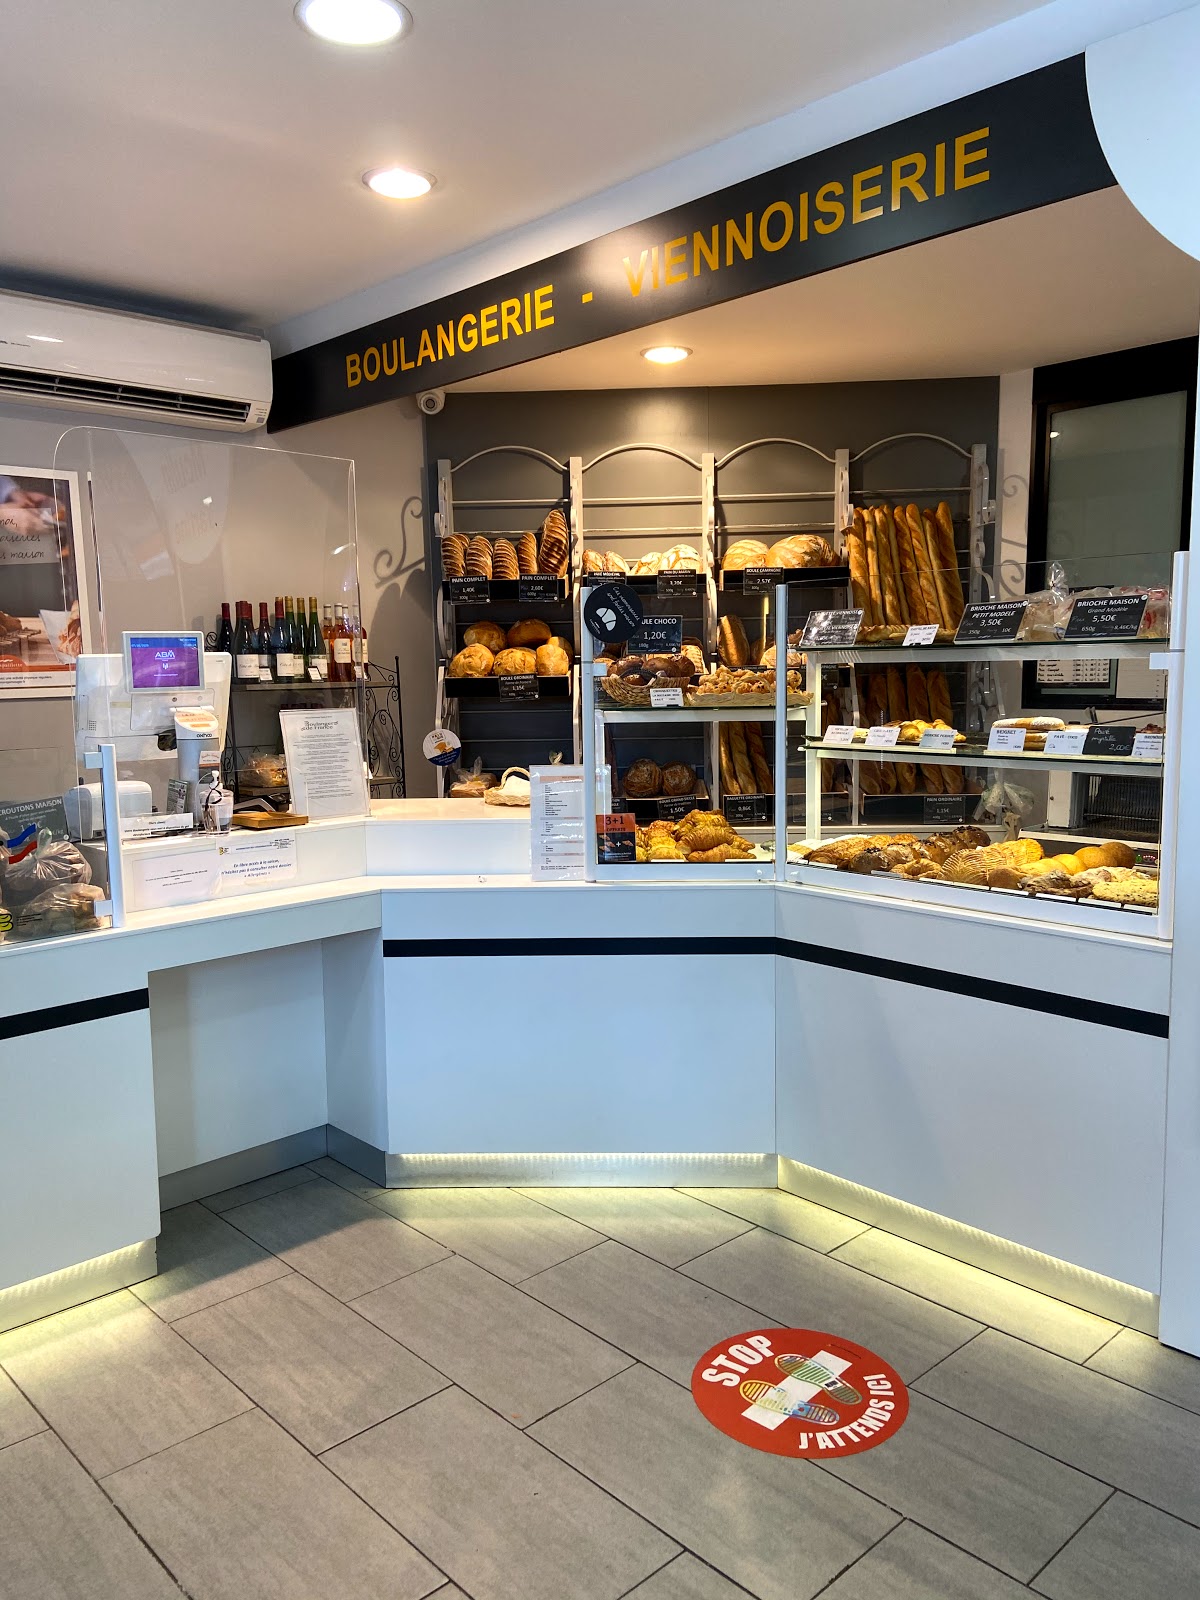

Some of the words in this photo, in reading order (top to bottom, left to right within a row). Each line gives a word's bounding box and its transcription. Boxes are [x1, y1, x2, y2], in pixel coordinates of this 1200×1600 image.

[346, 284, 554, 388] BOULANGERIE
[622, 126, 990, 297] VIENNOISERIE
[11, 551, 45, 559] maison
[970, 604, 997, 612] BRIOCHE
[980, 618, 1002, 626] 3,50€
[1092, 615, 1116, 623] 5,50€
[643, 631, 667, 640] 1,20€
[36, 799, 62, 809] MAISON
[605, 817, 624, 825] 3+1
[701, 1335, 774, 1387] STOP
[799, 1399, 895, 1450] J'ATTENDS
[862, 1374, 894, 1396] ICI
